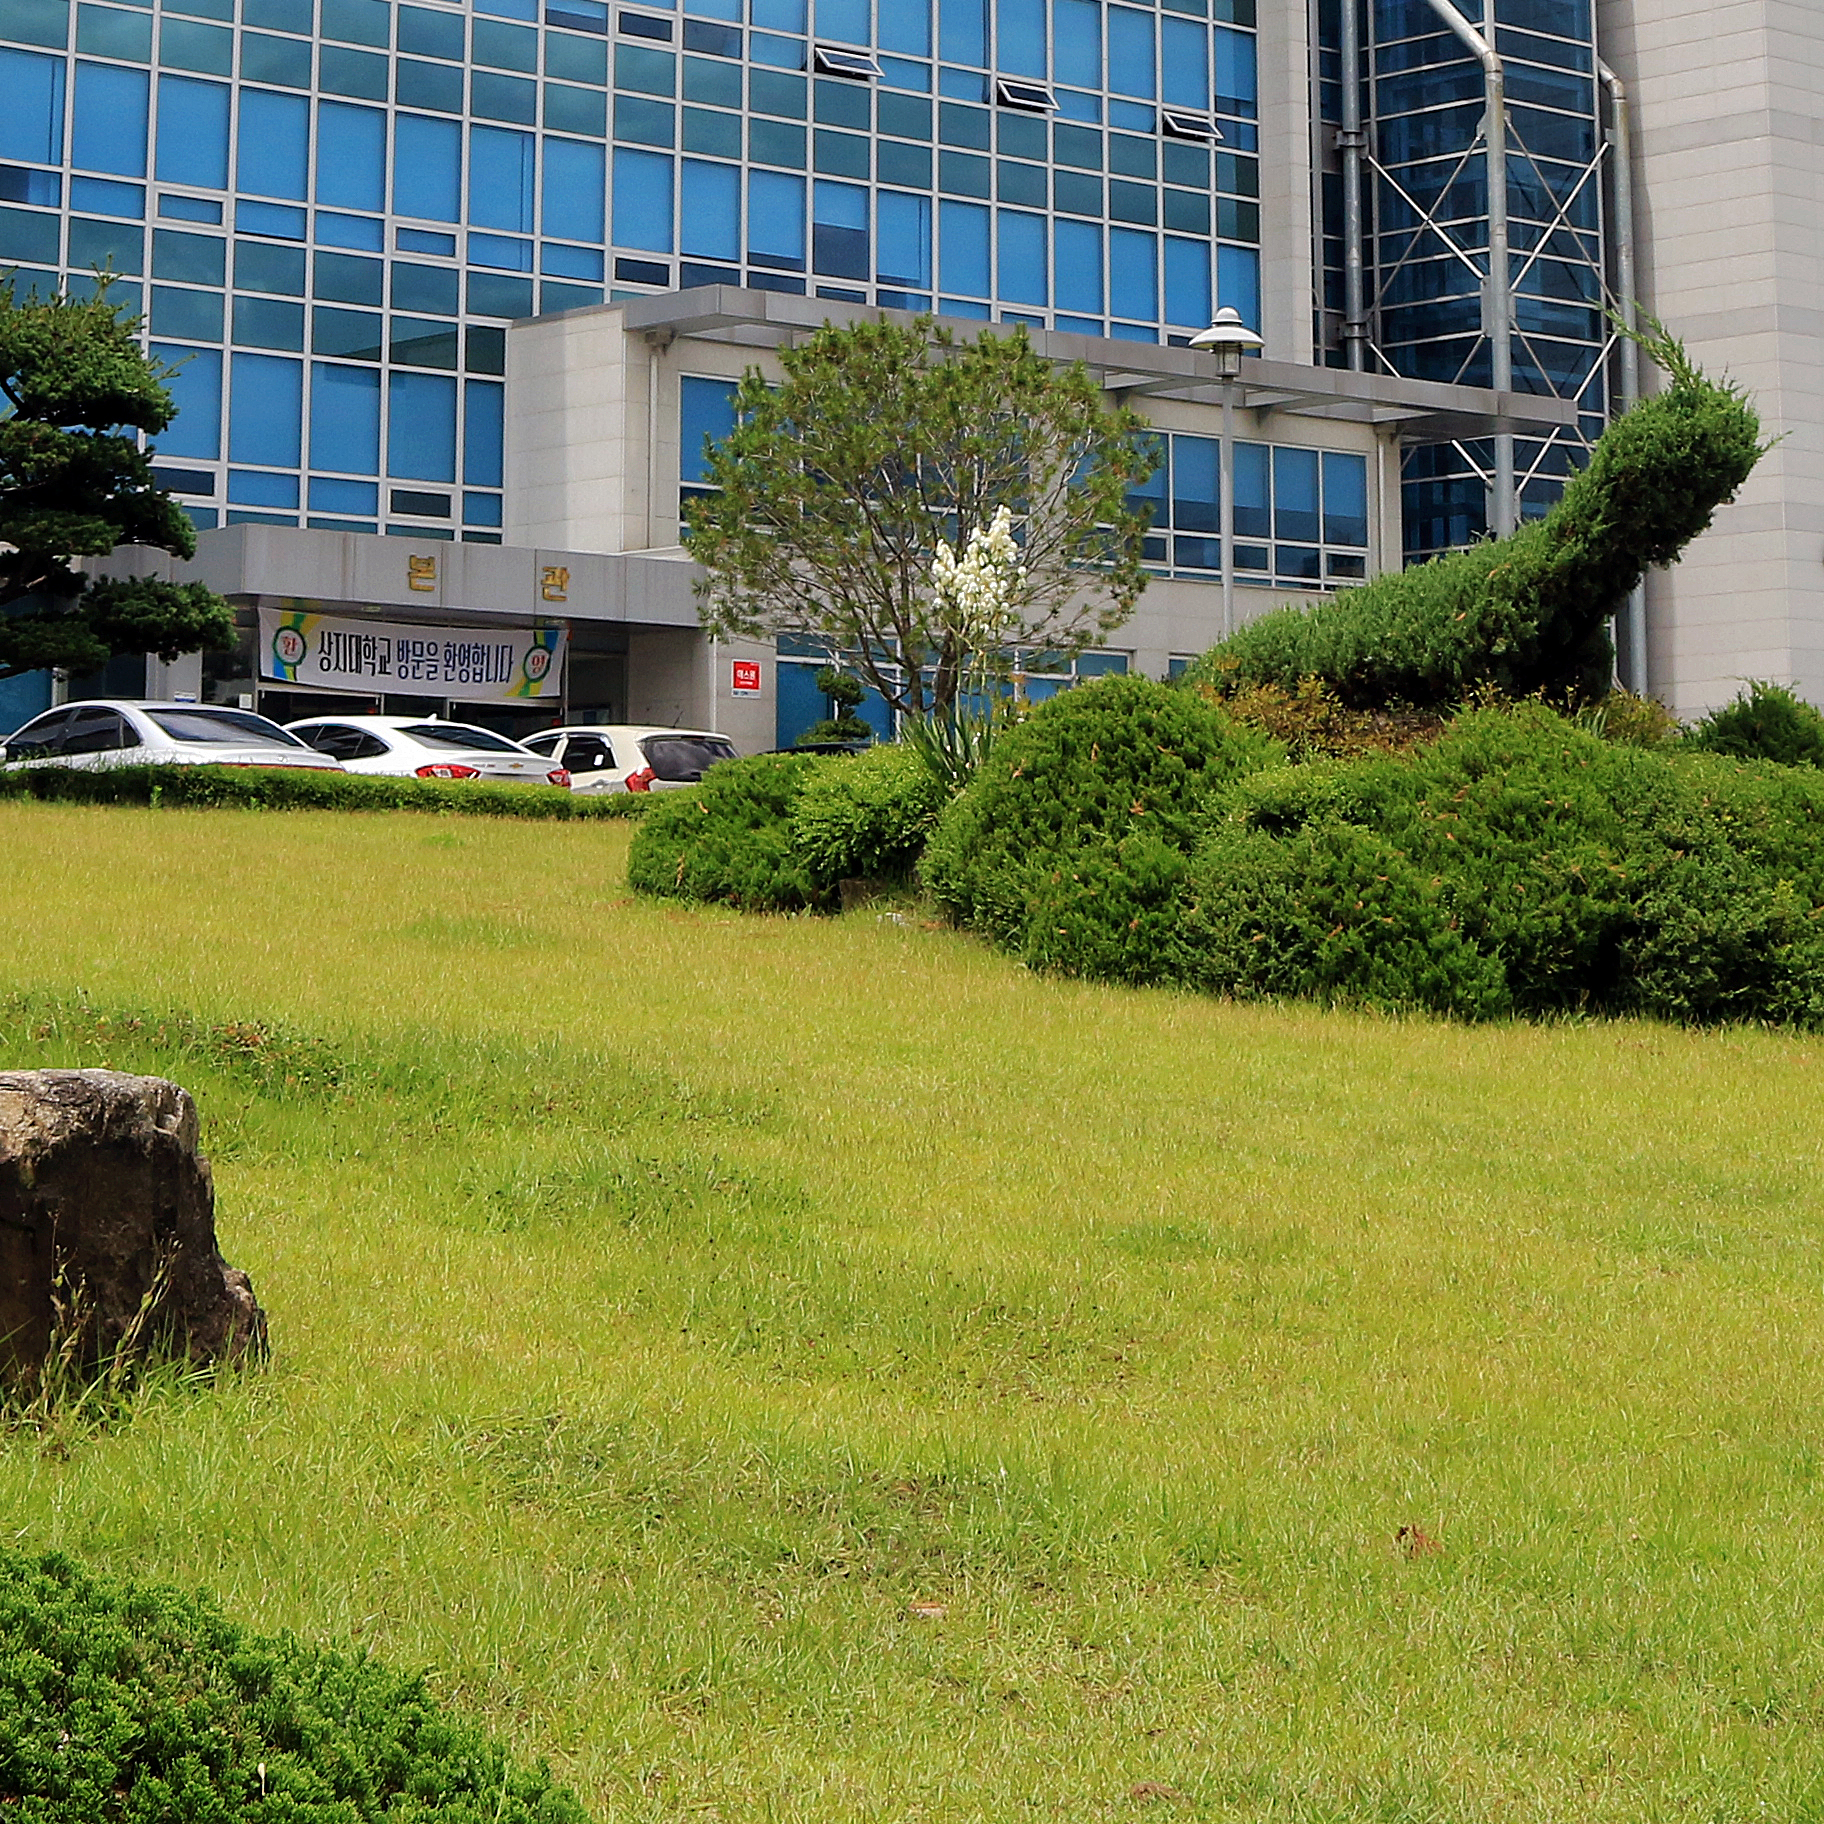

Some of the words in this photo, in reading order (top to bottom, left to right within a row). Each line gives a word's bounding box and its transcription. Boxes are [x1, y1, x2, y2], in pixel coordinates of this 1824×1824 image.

[318, 630, 393, 677] 상지대학교
[397, 639, 440, 681] 방문을
[443, 641, 515, 684] 환영합니다
